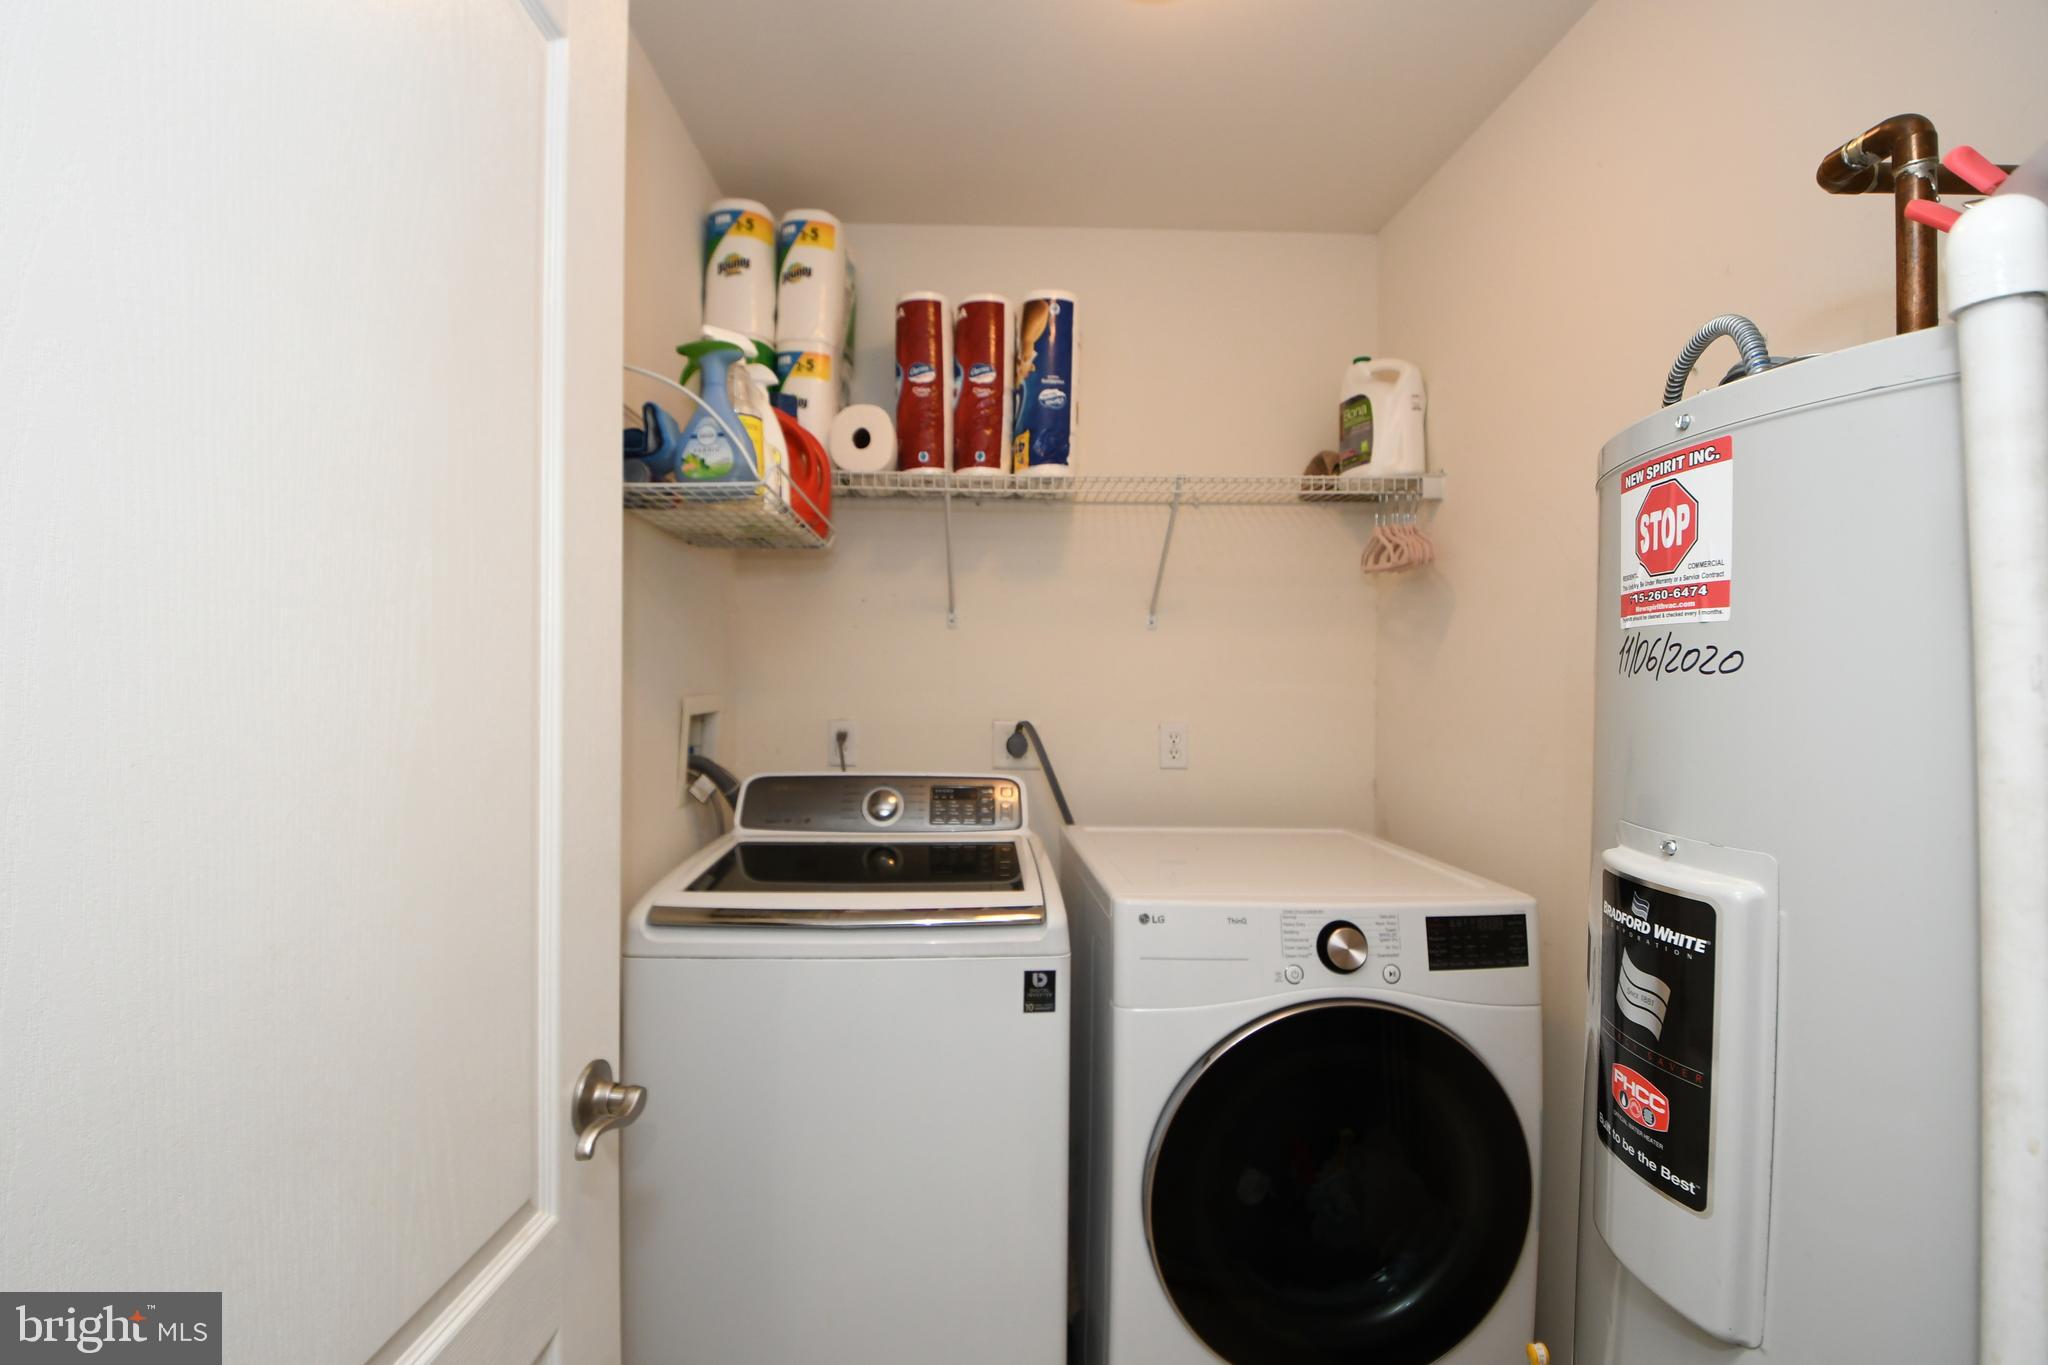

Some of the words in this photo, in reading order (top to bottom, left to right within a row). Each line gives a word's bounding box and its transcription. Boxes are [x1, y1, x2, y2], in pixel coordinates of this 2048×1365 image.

[1625, 471, 1644, 489] NEW
[1646, 454, 1686, 480] SPIRIT
[1688, 446, 1720, 467] INC.
[1639, 503, 1691, 554] STOP
[1683, 574, 1699, 582] Service
[1701, 571, 1725, 579] Contract
[1688, 559, 1725, 570] COMMERCIAL
[1630, 584, 1708, 604] 15-260-6474
[1619, 631, 1744, 682] 11/06/2020
[1151, 915, 1165, 924] LG
[1603, 900, 1652, 935] BRADFORD
[1653, 923, 1707, 954] WHITE
[1614, 1068, 1666, 1115] PHCC
[1612, 1128, 1621, 1144] to
[1622, 1137, 1635, 1156] be
[1637, 1150, 1657, 1172] the
[1660, 1165, 1696, 1195] Best
